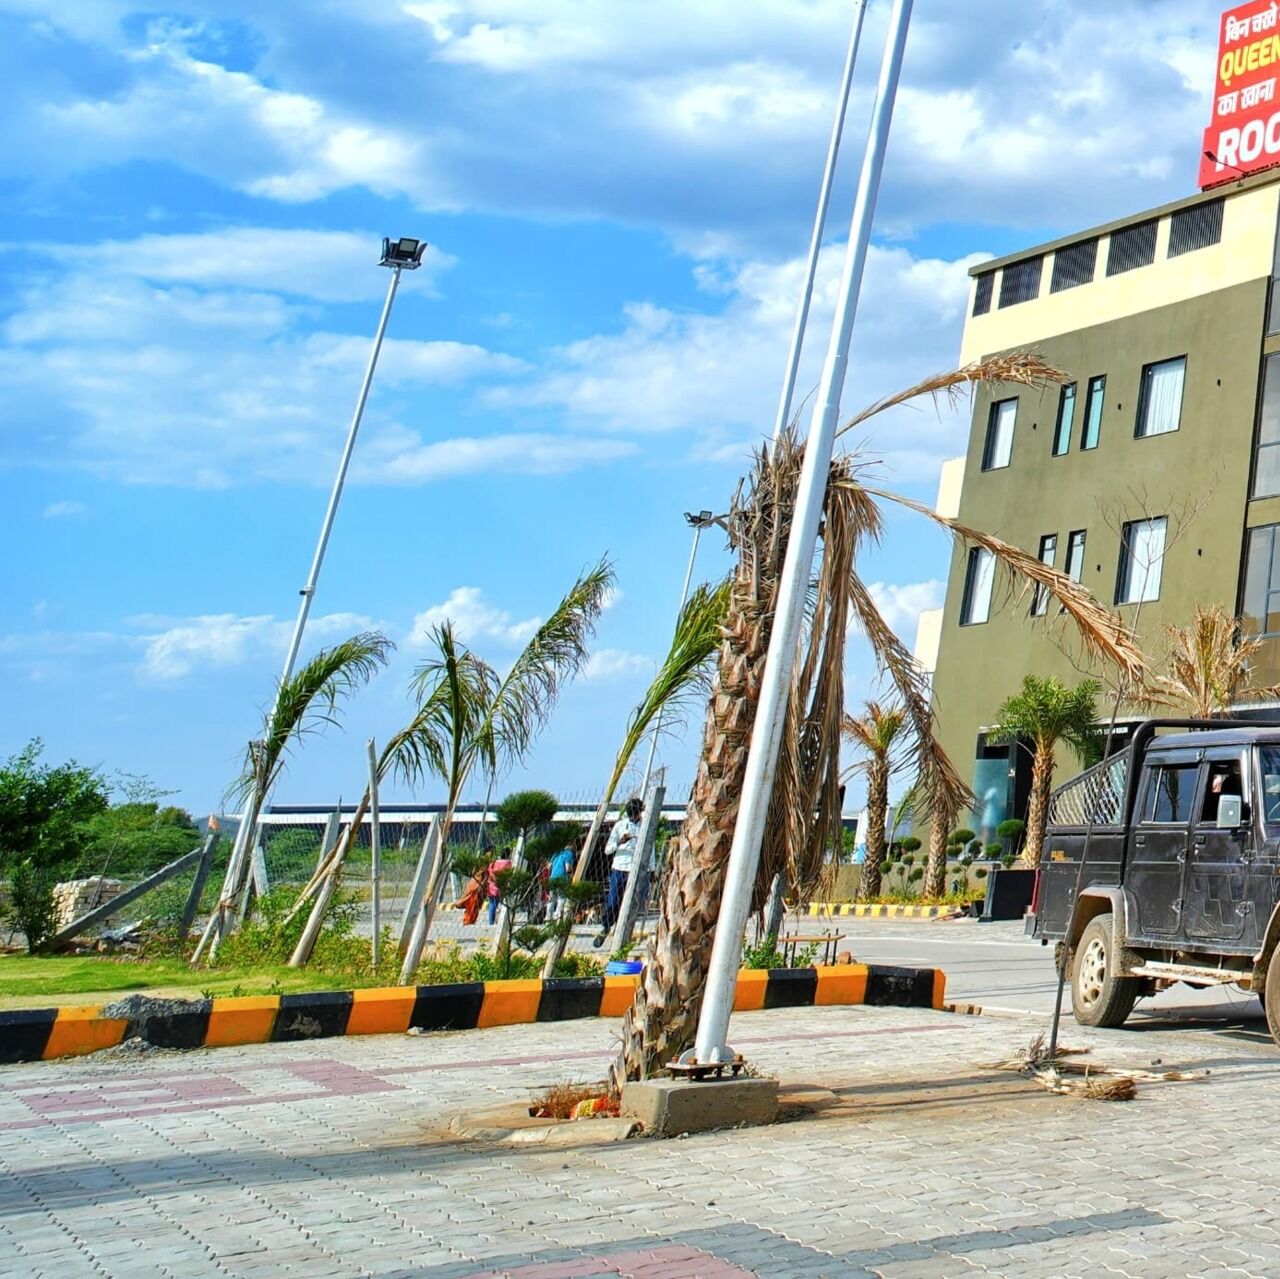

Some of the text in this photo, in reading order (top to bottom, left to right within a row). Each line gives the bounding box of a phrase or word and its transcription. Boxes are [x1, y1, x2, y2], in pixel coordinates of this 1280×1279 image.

[1225, 15, 1250, 44] बिन
[1251, 1, 1278, 33] चखे
[1217, 77, 1276, 116] का खाना
